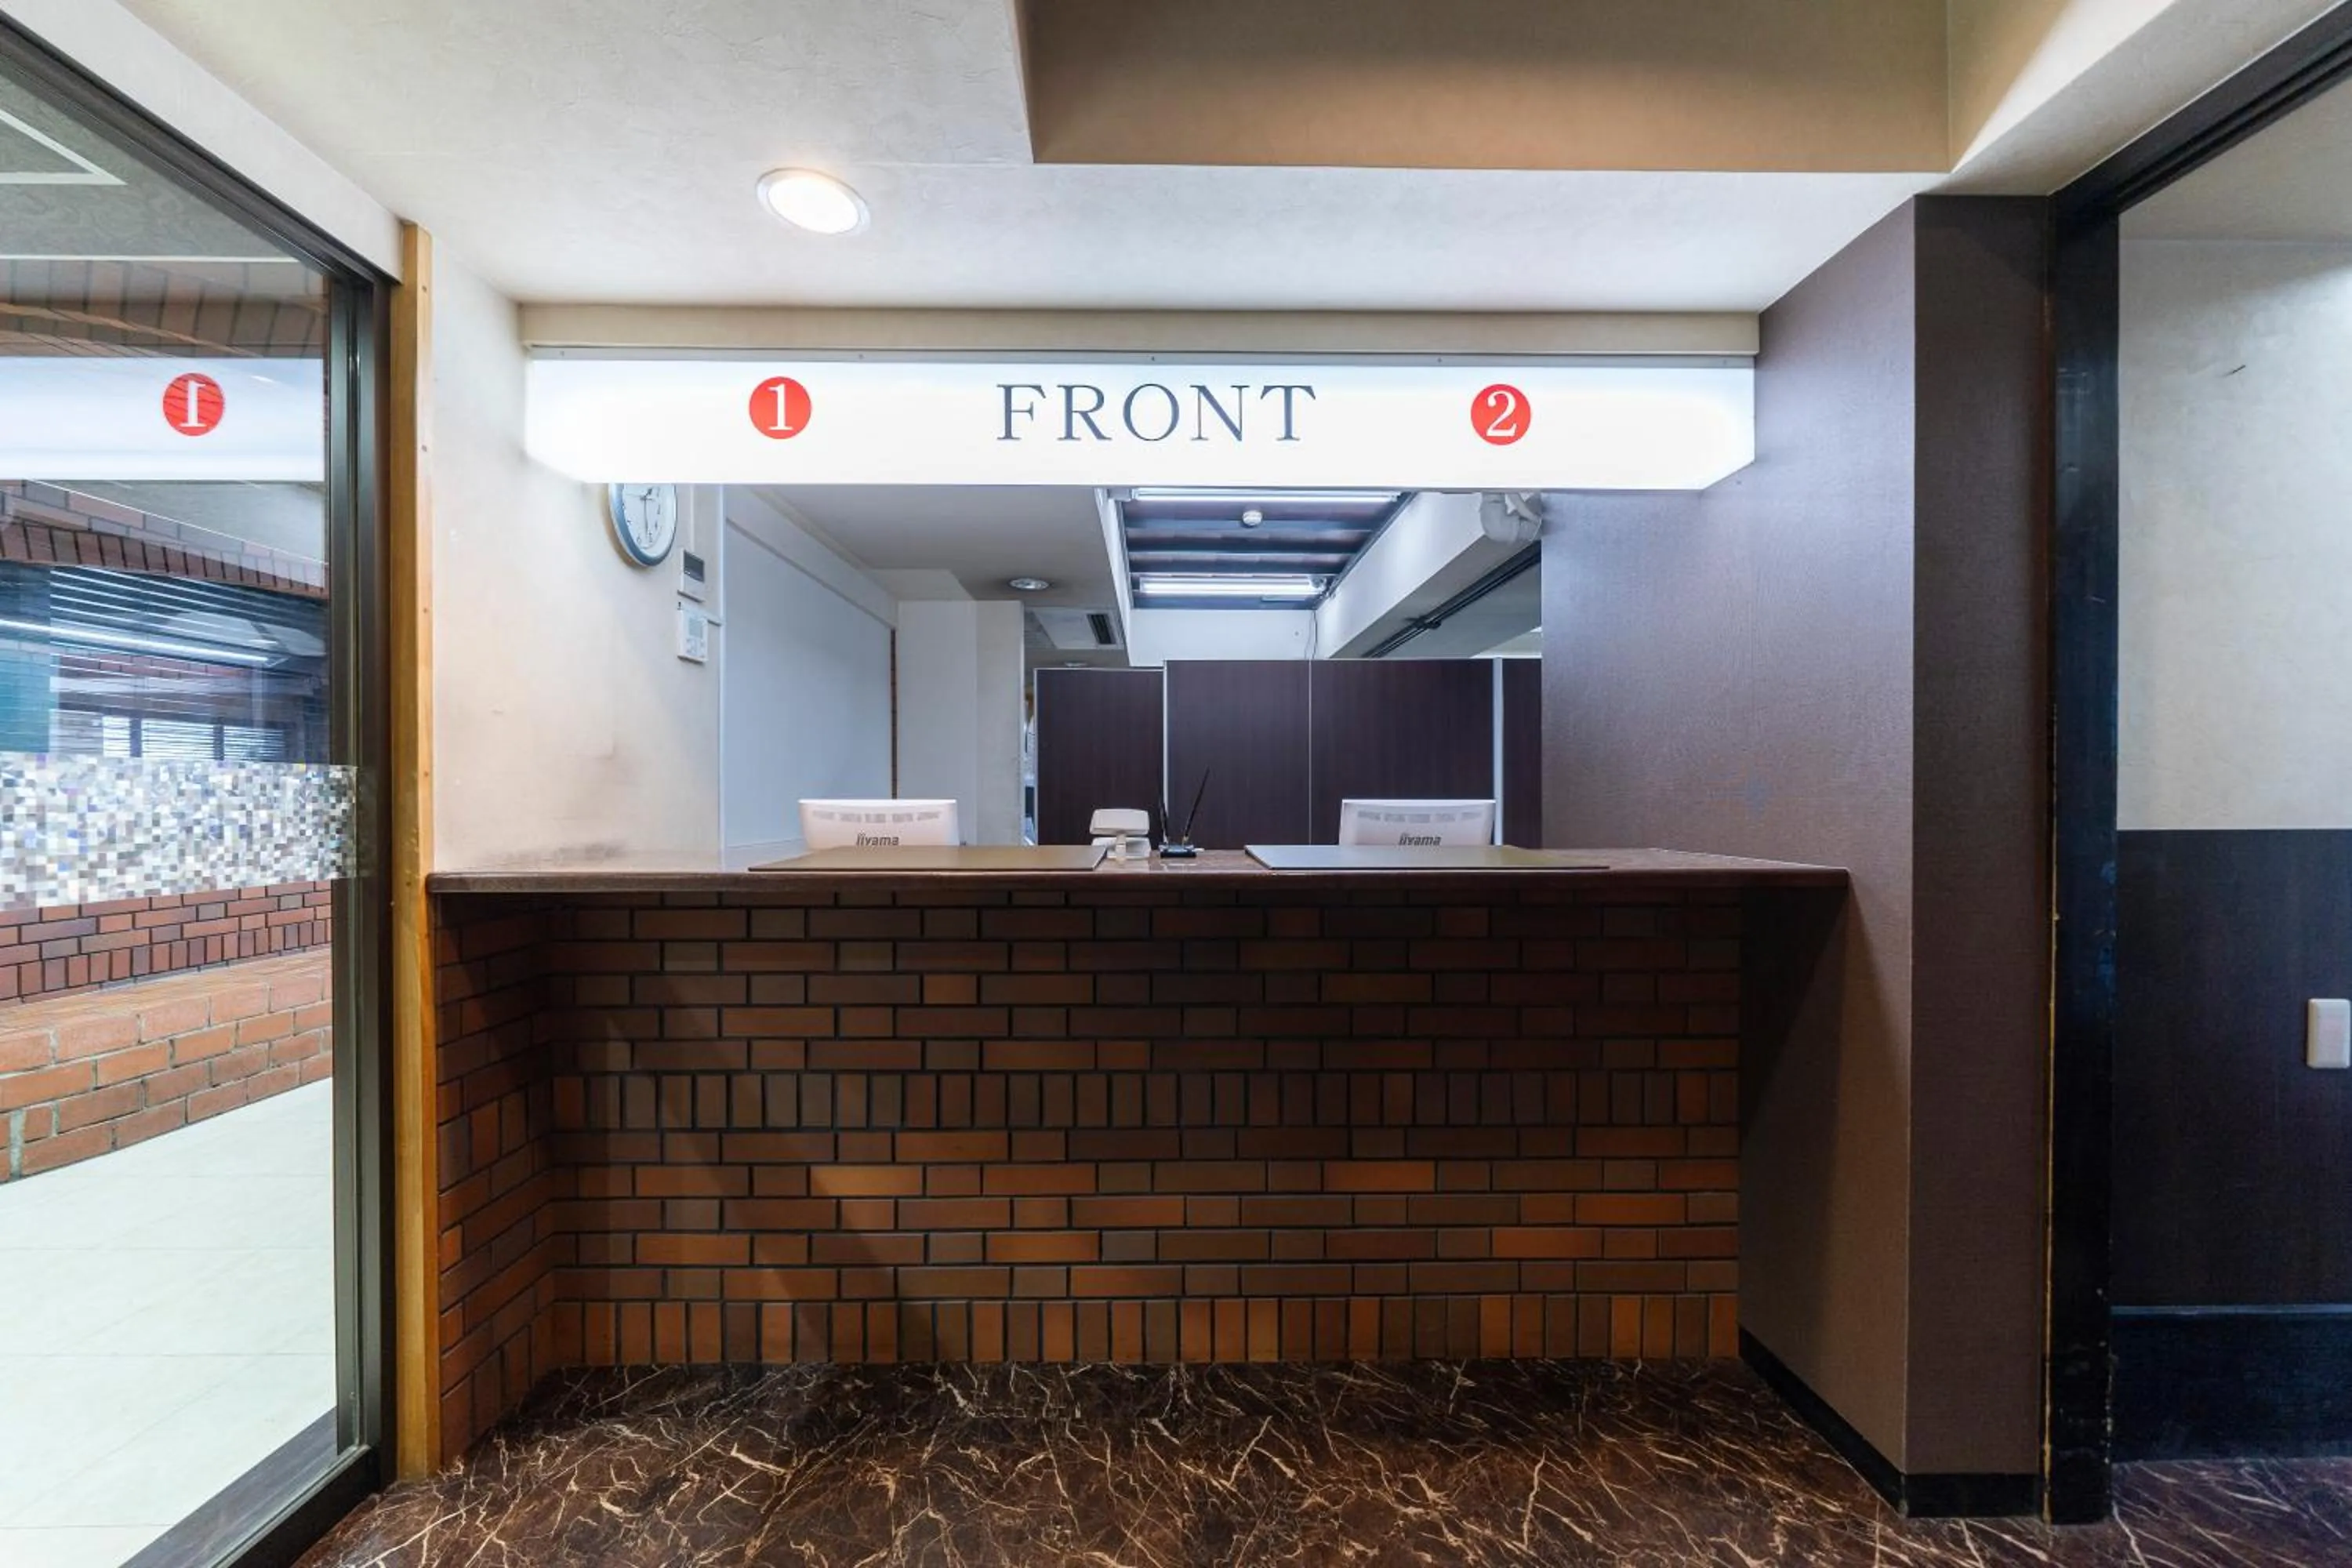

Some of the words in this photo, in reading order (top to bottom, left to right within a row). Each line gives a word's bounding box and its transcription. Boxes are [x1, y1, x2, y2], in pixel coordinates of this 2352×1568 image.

[768, 383, 793, 430] 1
[996, 383, 1316, 441] FRONT
[1485, 390, 1518, 437] 2
